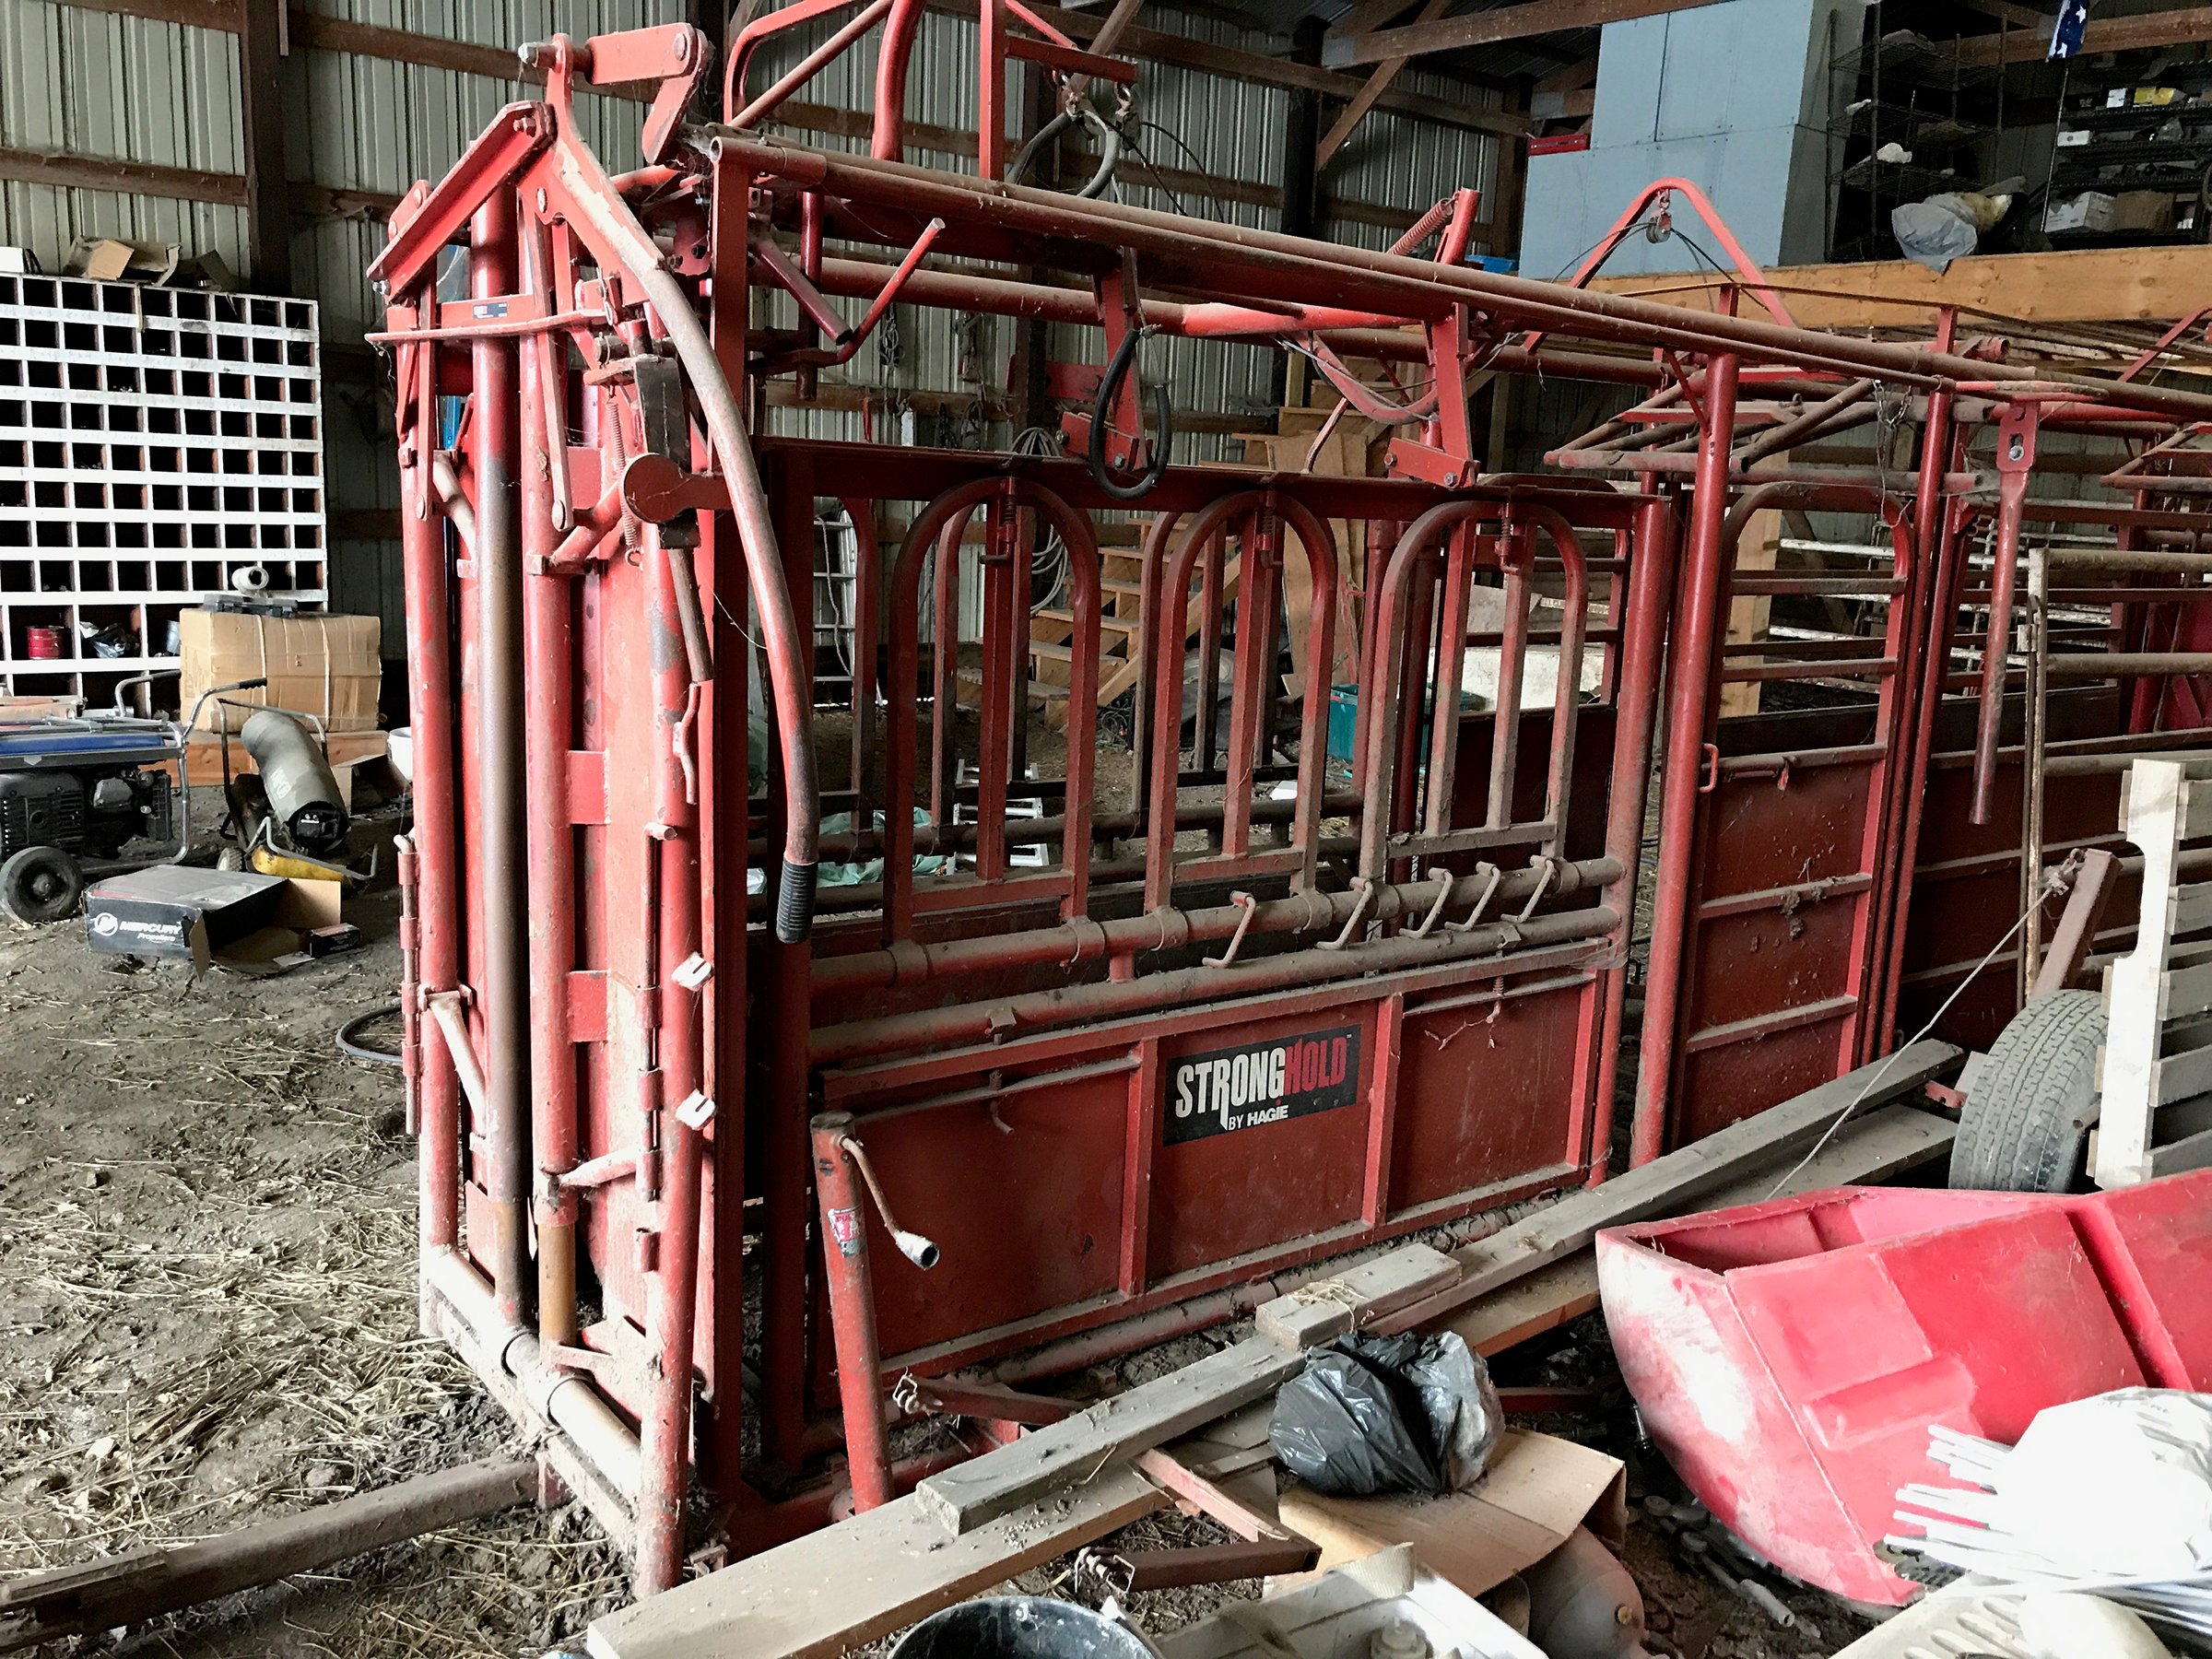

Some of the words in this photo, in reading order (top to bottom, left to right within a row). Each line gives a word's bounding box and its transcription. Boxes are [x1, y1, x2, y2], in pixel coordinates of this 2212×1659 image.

[119, 921, 182, 935] MERCURY
[1175, 1035, 1347, 1131] STRONGHOLD
[1228, 1114, 1244, 1131] BY
[1247, 1103, 1289, 1127] HAGIE
